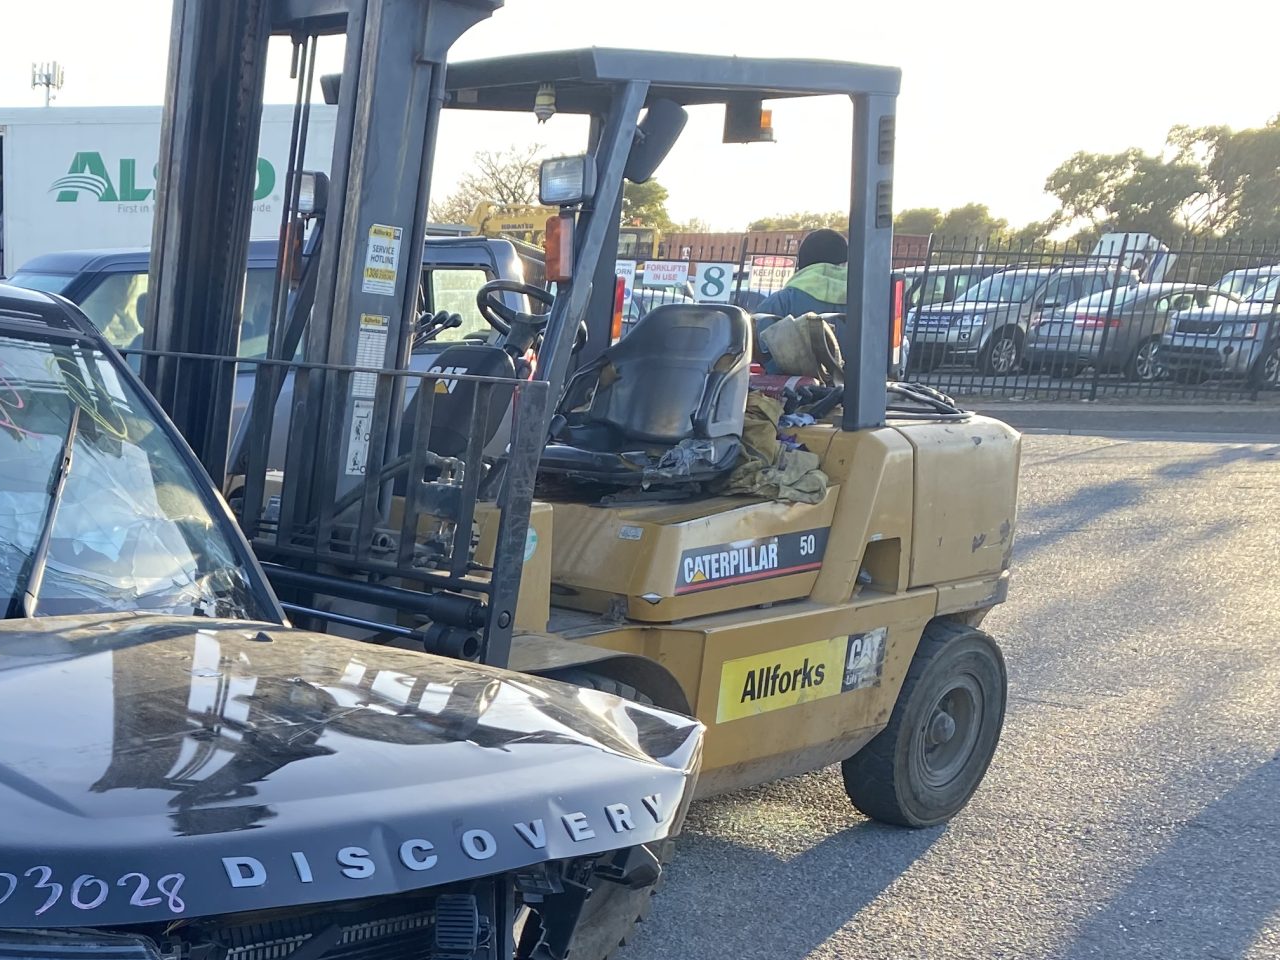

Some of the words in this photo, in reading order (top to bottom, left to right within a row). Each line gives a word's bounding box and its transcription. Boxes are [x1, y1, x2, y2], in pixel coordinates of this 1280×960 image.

[48, 151, 276, 202] ALO
[117, 204, 138, 213] First
[140, 204, 149, 213] in
[370, 254, 394, 265] HOTLINE
[372, 244, 395, 255] SERVICE
[646, 264, 687, 273] FORKLIFTS
[662, 273, 678, 281] USE
[753, 268, 773, 277] KEEP
[775, 269, 792, 278] OUT
[701, 266, 726, 297] 8
[683, 543, 778, 583] CATERPILLAR
[800, 534, 816, 556] 50
[847, 632, 883, 669] CAT
[740, 658, 825, 703] Allforks
[221, 793, 663, 888] DISCOVERY
